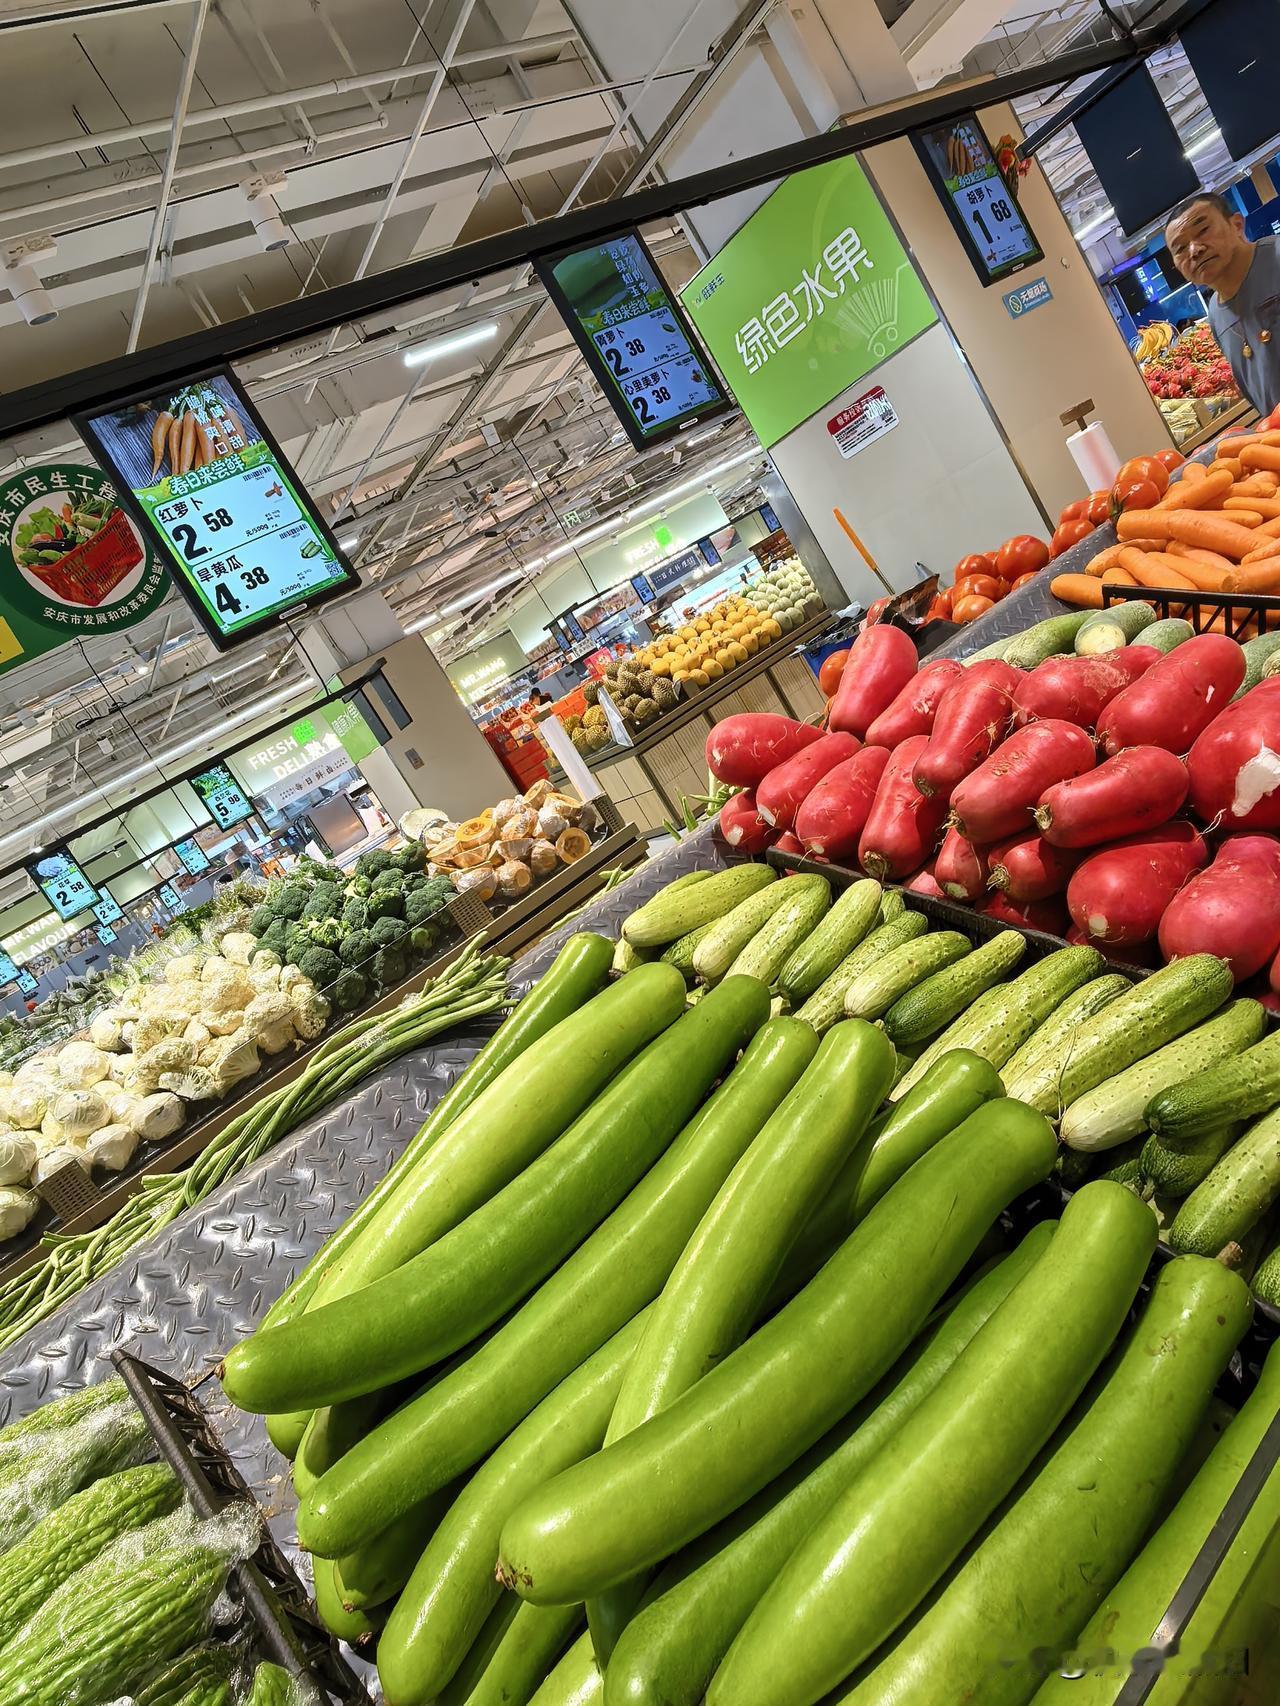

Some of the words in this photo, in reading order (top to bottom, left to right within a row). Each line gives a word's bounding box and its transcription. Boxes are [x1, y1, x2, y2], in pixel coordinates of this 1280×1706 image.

[990, 199, 1012, 222] 68
[734, 226, 875, 376] 绿色水果
[625, 338, 646, 357] 38
[624, 369, 670, 395] 心里美萝卜
[651, 386, 672, 404] 38
[169, 454, 246, 495] 春日来尝鲜
[158, 496, 204, 524] 红萝卜
[202, 507, 234, 533] 58
[196, 554, 244, 582] 旱黄瓜
[240, 566, 270, 590] 38
[247, 735, 299, 771] FRESH
[227, 794, 241, 805] 98
[70, 881, 85, 893] 58
[11, 922, 79, 965] FLAVOUR
